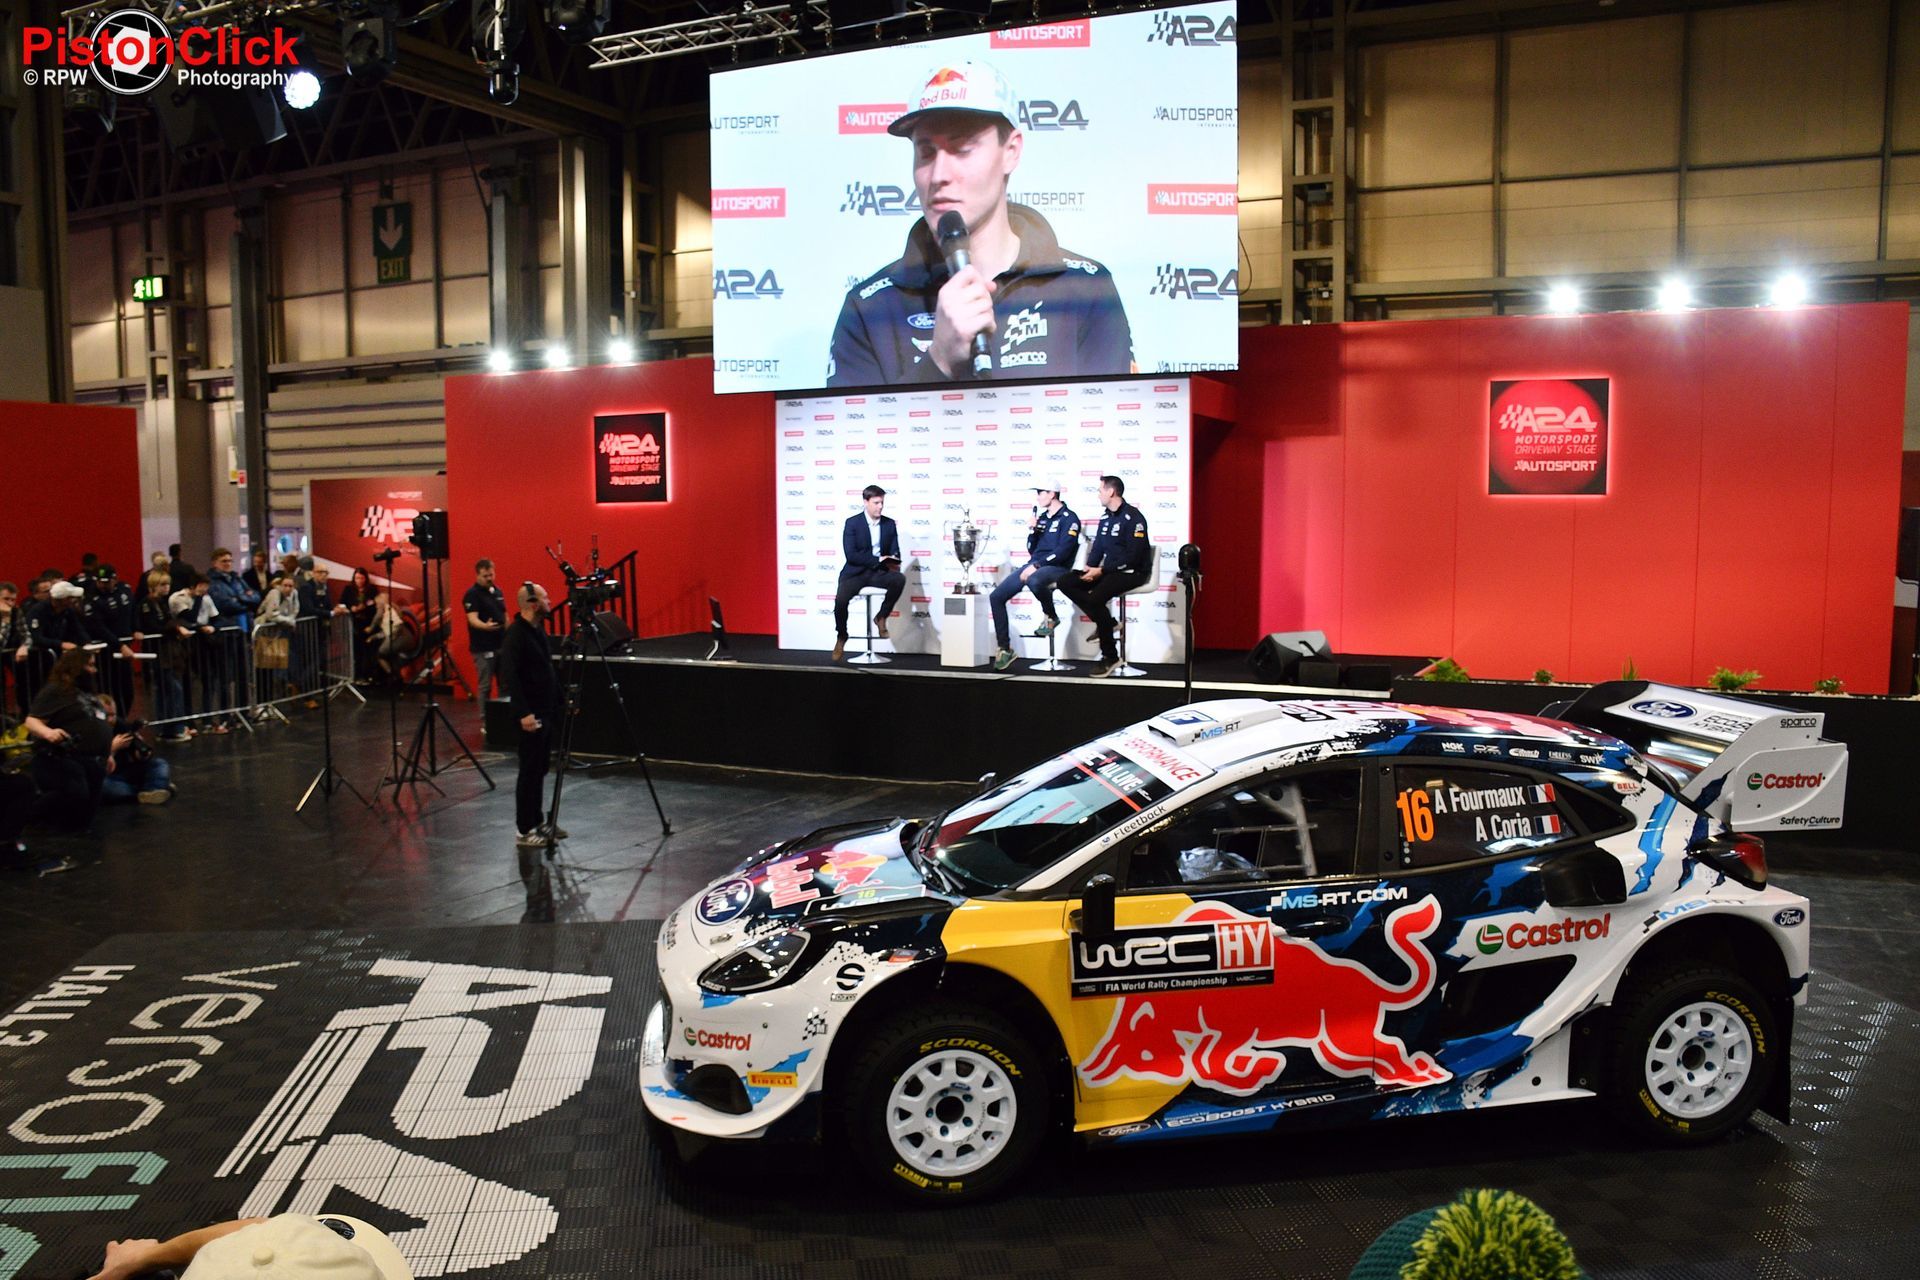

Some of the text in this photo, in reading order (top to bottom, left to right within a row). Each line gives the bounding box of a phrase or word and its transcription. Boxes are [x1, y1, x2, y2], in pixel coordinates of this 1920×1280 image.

[1005, 25, 1084, 41] AUTOSPORT
[941, 88, 966, 101] Bull
[711, 115, 780, 130] UTOSPORT
[1018, 99, 1090, 131] A24
[1006, 192, 1085, 206] AUTOSPORT
[1162, 191, 1238, 207] AUTOSPOR
[380, 258, 404, 279] EXIT
[713, 359, 780, 373] UTOSPORT
[1000, 351, 1048, 369] sparco
[1515, 405, 1598, 433] A24
[610, 433, 660, 456] A24
[1515, 434, 1597, 444] MOTORSPORT
[1515, 444, 1597, 454] DRIVEWAY STAGE
[1520, 461, 1598, 471] AUTOSPORT
[1201, 721, 1241, 740] MS-RT
[1780, 717, 1817, 728] sparco
[1441, 742, 1465, 751] NGK
[1764, 772, 1823, 789] Castrol
[1113, 805, 1167, 839] Fleetback
[1397, 786, 1526, 842] 16 A Fourmaux
[1779, 816, 1840, 827] SafetyCulture
[1476, 812, 1532, 842] A Coria
[703, 879, 750, 920] Ford
[1778, 908, 1803, 926] Ford
[1507, 912, 1611, 949] Castrol
[1080, 933, 1211, 969] WRC
[1221, 922, 1269, 968] HY
[1105, 983, 1120, 992] FIA
[1121, 981, 1146, 991] World
[1147, 979, 1169, 991] Rally
[1170, 976, 1228, 988] Championship
[0, 964, 136, 1028] HALL
[1705, 991, 1766, 1053] SCORPION
[698, 1029, 751, 1051] Castrol
[920, 1038, 1022, 1076] SCORPION
[1105, 1094, 1335, 1137] Ford ECOBOOST HYBRID
